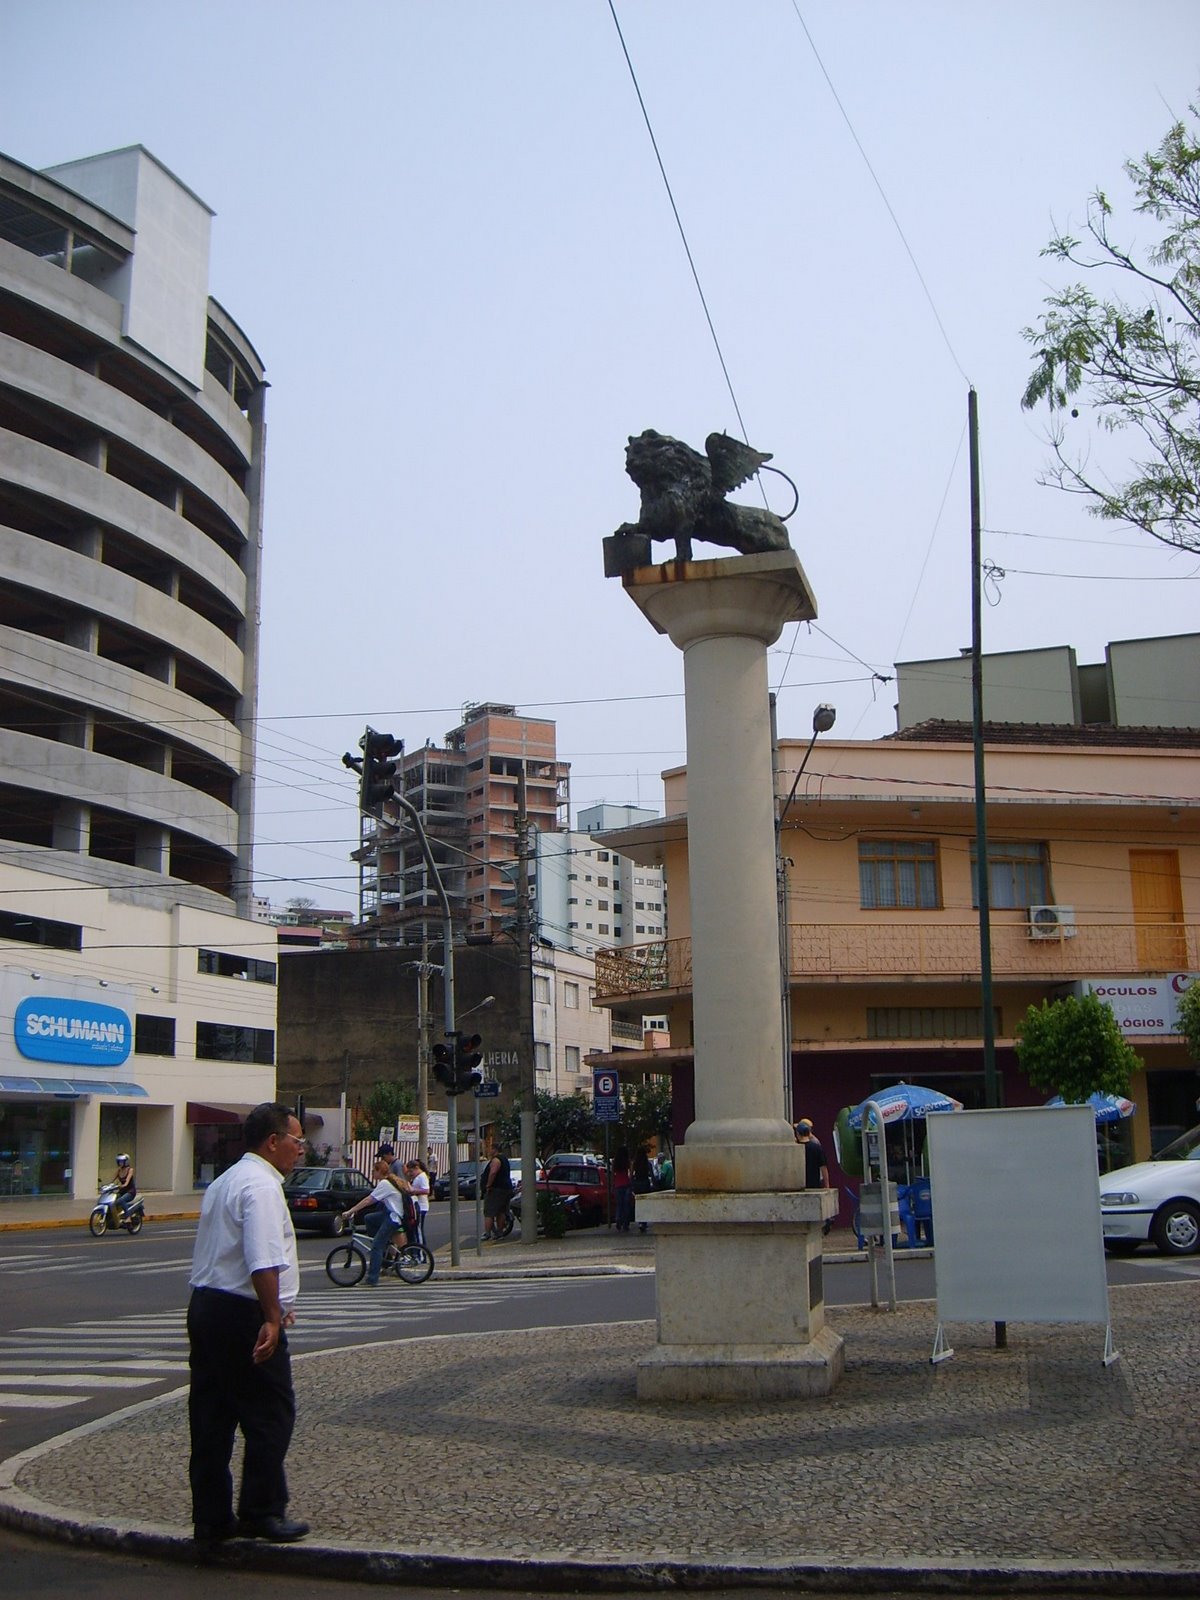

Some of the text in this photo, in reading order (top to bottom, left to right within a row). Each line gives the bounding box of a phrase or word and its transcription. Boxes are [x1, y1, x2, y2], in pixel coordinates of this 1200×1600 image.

[1096, 986, 1158, 996] ÓCULOS
[26, 1013, 124, 1044] SCHUMANN
[1115, 1017, 1164, 1028] LÓGIOS
[482, 1051, 519, 1065] LHERIA
[602, 1078, 610, 1091] E
